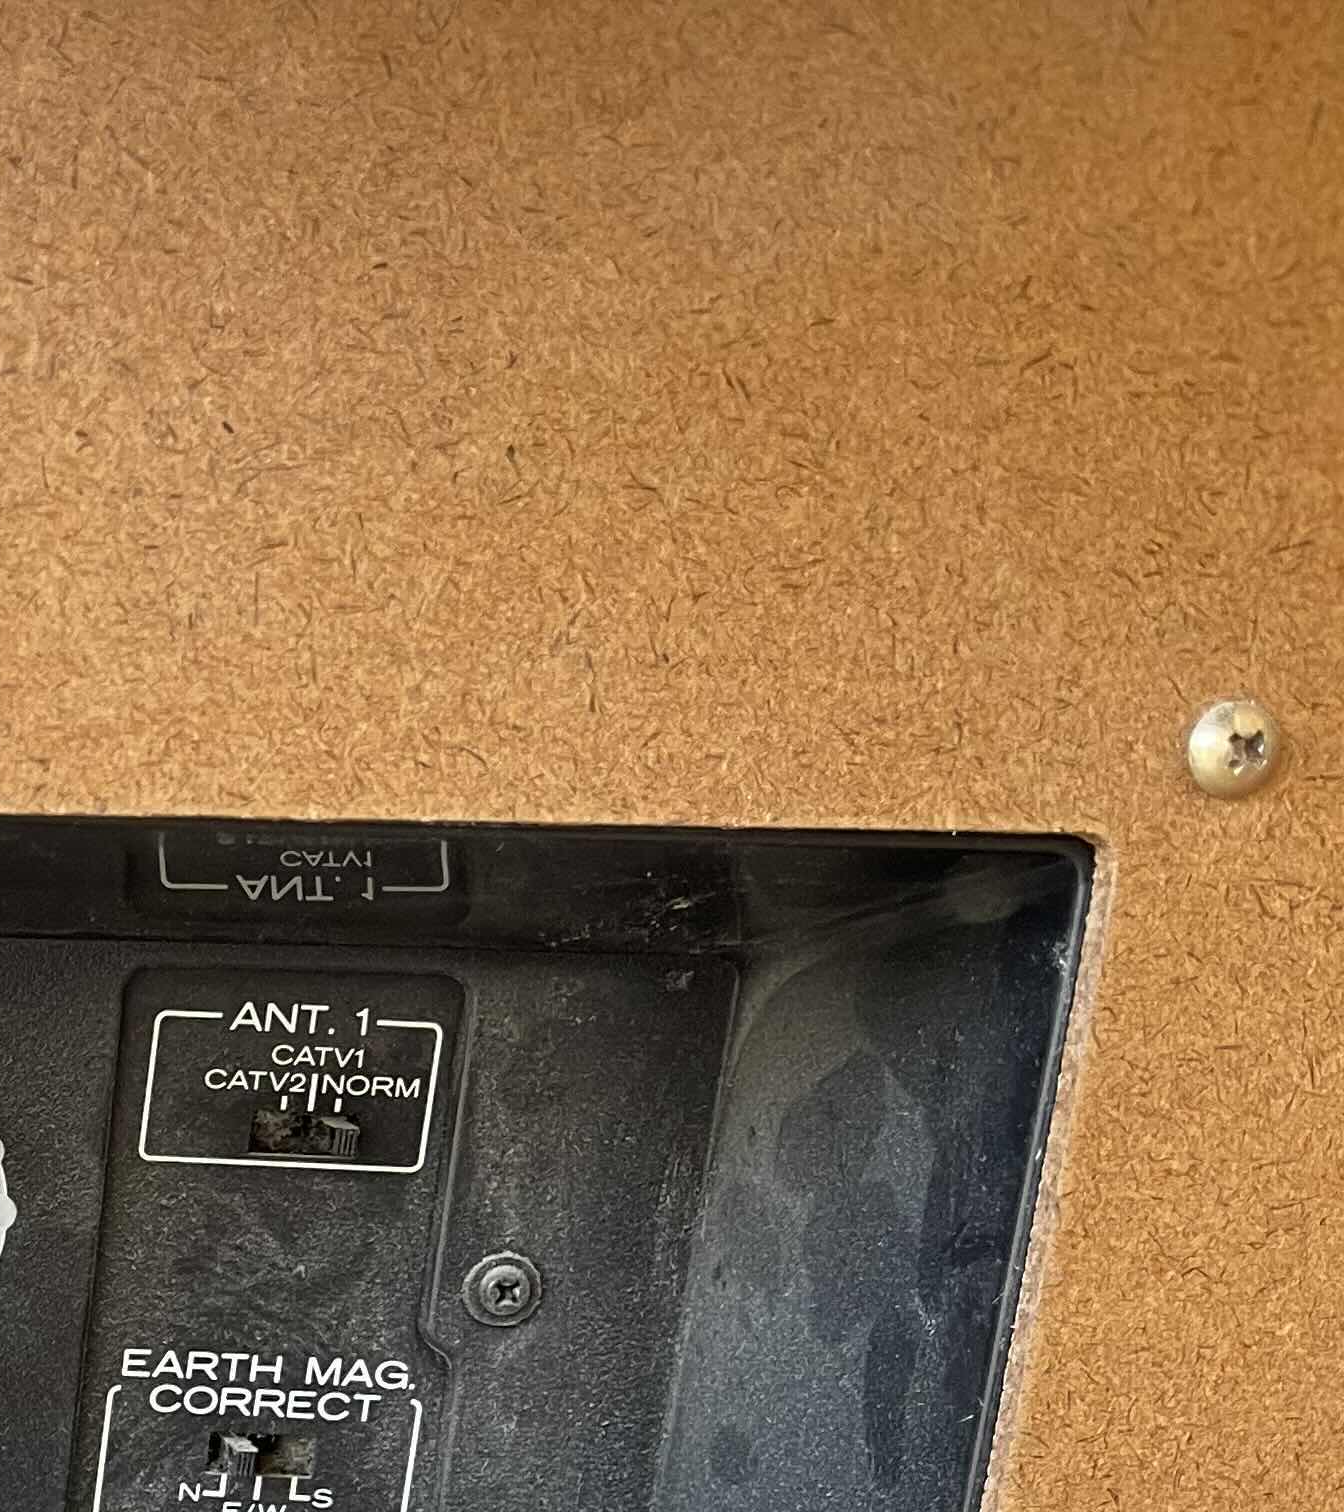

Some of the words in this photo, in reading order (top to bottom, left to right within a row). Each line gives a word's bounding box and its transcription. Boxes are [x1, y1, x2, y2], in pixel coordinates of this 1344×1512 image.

[229, 1000, 336, 1036] ANT.
[355, 1006, 372, 1037] 1
[271, 1043, 366, 1069] CATV1
[203, 1067, 307, 1094] CATV2
[320, 1073, 421, 1099] NORM
[120, 1348, 285, 1385] EARTH
[304, 1356, 416, 1392] MAG.
[148, 1383, 383, 1423] CORRECT
[178, 1481, 203, 1504] N
[312, 1488, 334, 1510] S
